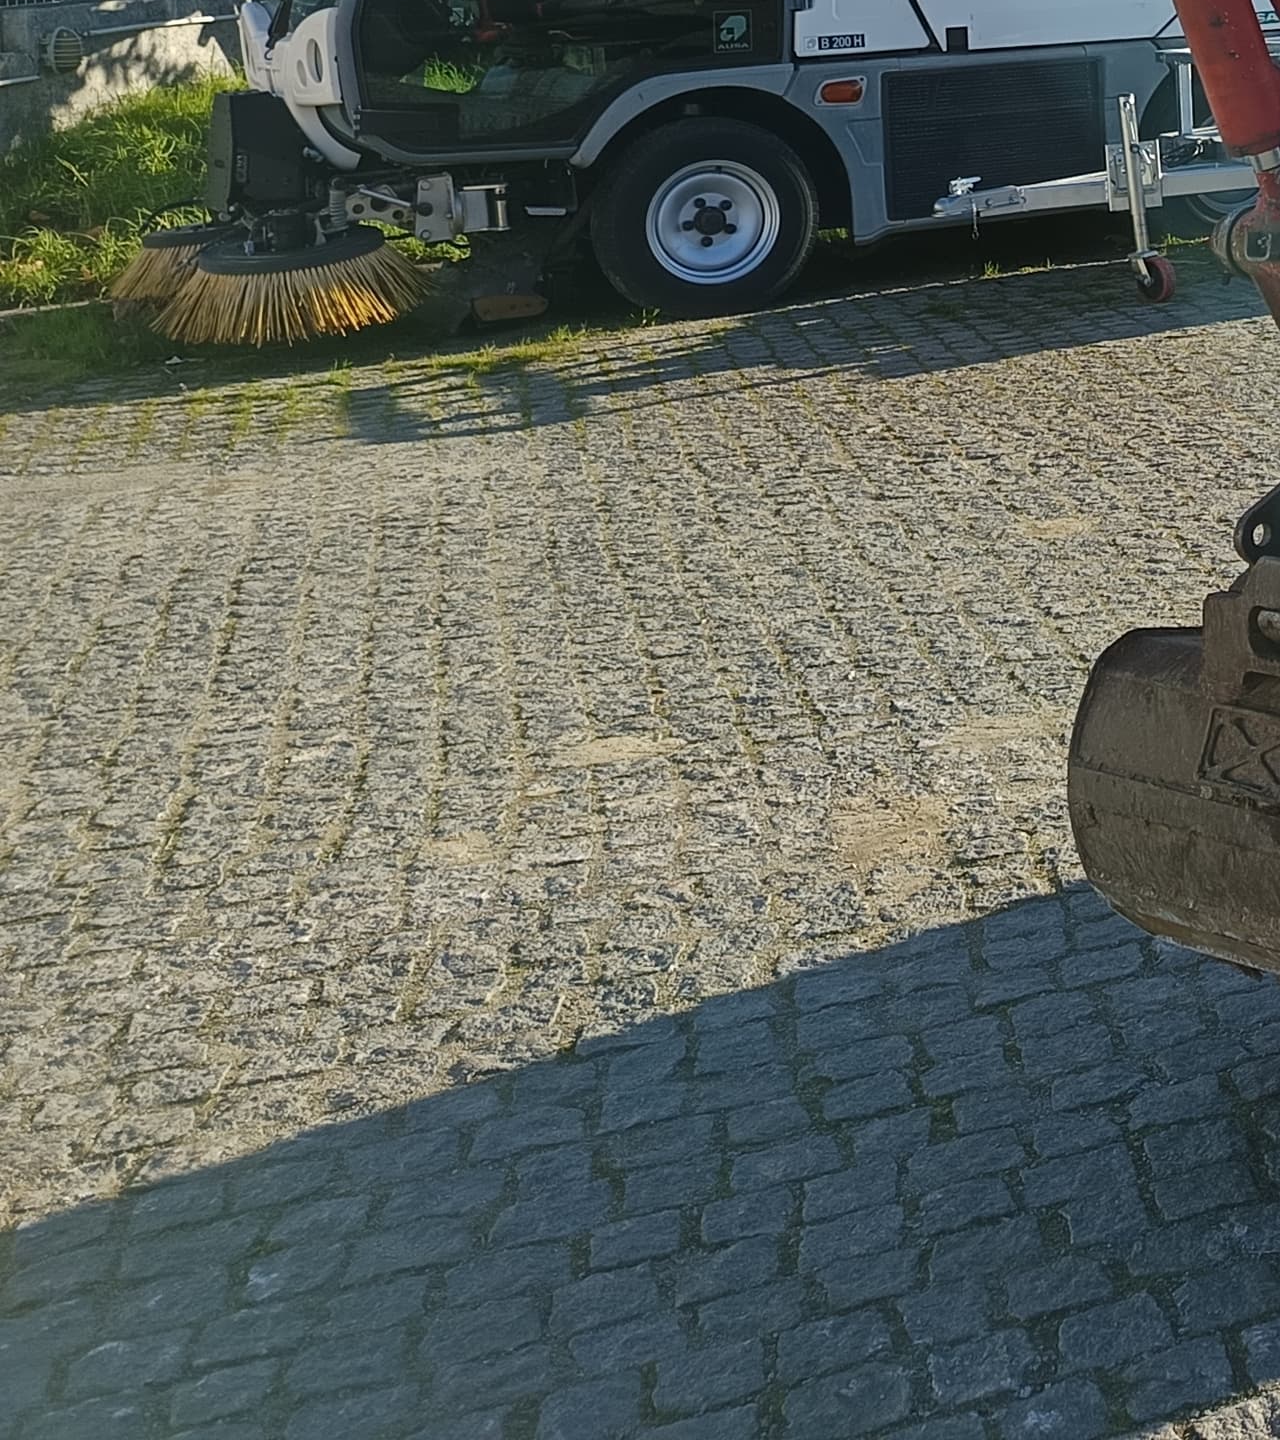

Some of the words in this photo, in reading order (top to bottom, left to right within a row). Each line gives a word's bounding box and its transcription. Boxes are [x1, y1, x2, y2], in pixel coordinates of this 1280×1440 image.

[1257, 12, 1280, 23] SA
[820, 38, 830, 49] B
[832, 36, 851, 48] 200
[853, 35, 863, 47] H
